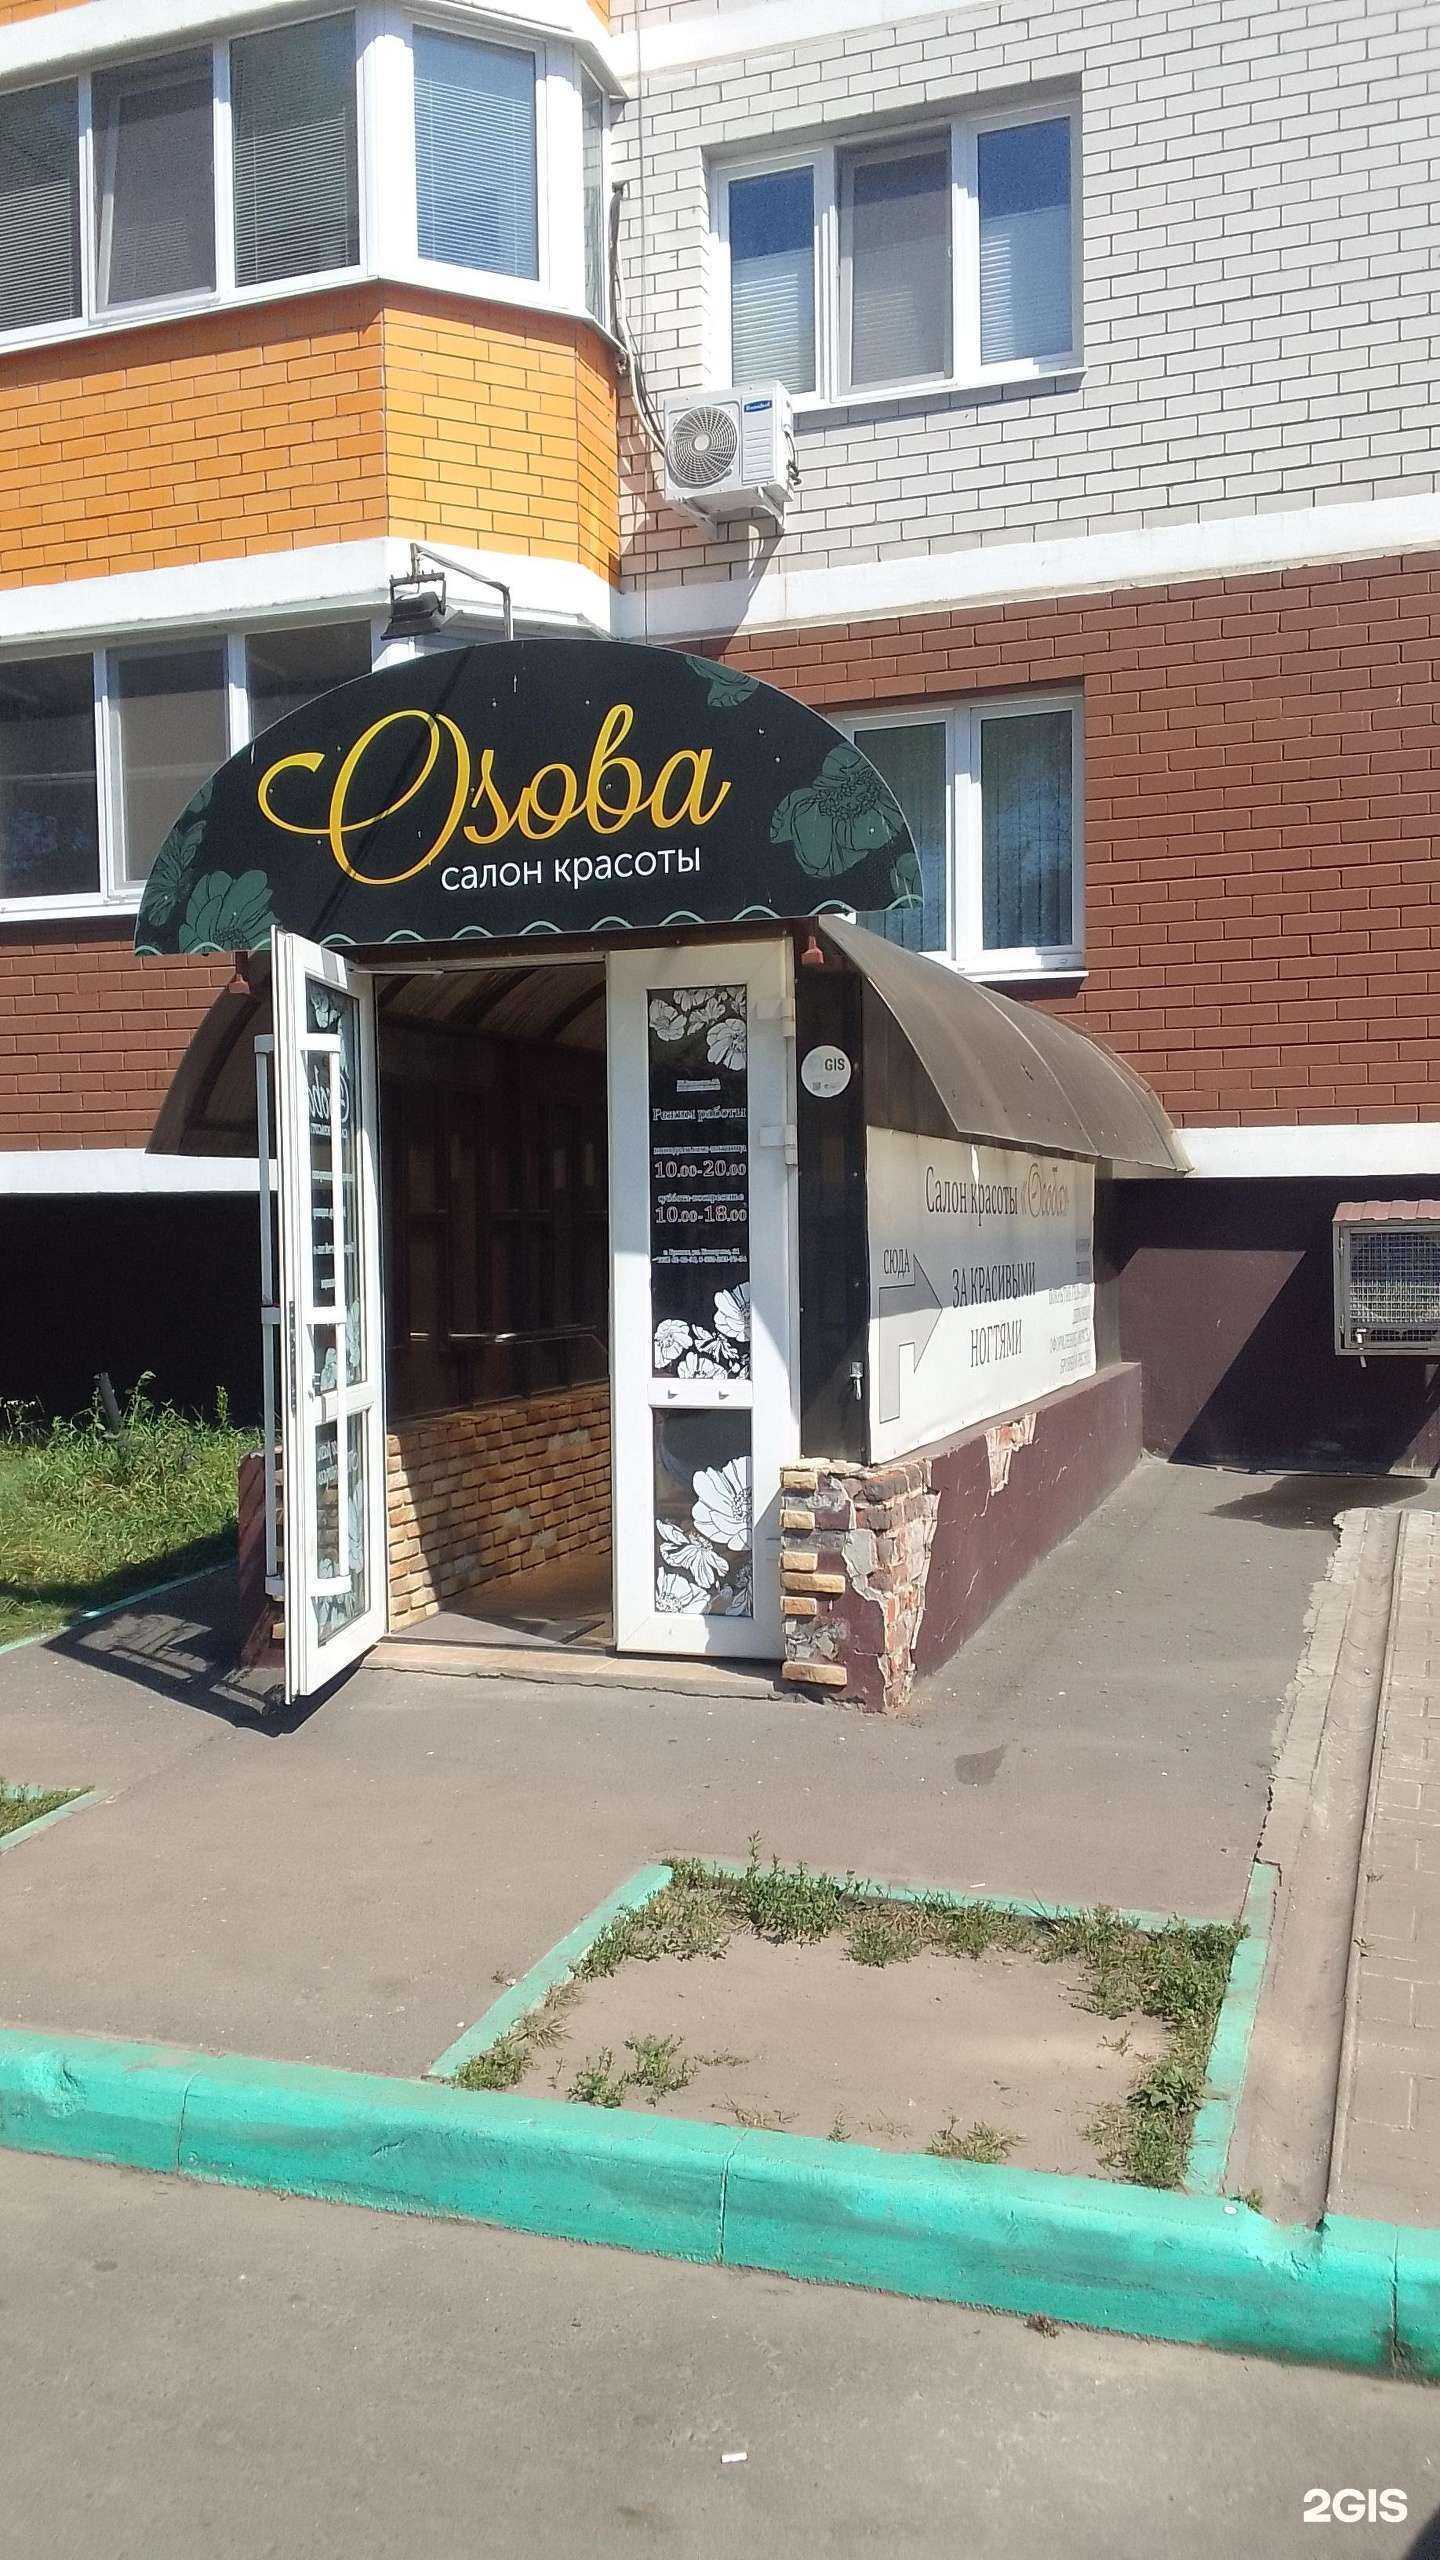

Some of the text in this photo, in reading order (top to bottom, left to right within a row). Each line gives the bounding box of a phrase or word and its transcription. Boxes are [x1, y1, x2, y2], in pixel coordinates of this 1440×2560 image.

[440, 844, 702, 892] салон красоты
[697, 1105, 747, 1122] работы
[654, 1160, 747, 1178] 10.00-20.00
[655, 1205, 747, 1223] 10.00-18.00
[925, 1166, 967, 1214] Салон
[971, 1183, 1018, 1227] красоты
[883, 1248, 911, 1279] СЮДА
[952, 1268, 968, 1309] ЗА
[970, 1261, 1037, 1306] КРАСИВЫМИ
[970, 1319, 1023, 1368] НОГТЯМИ
